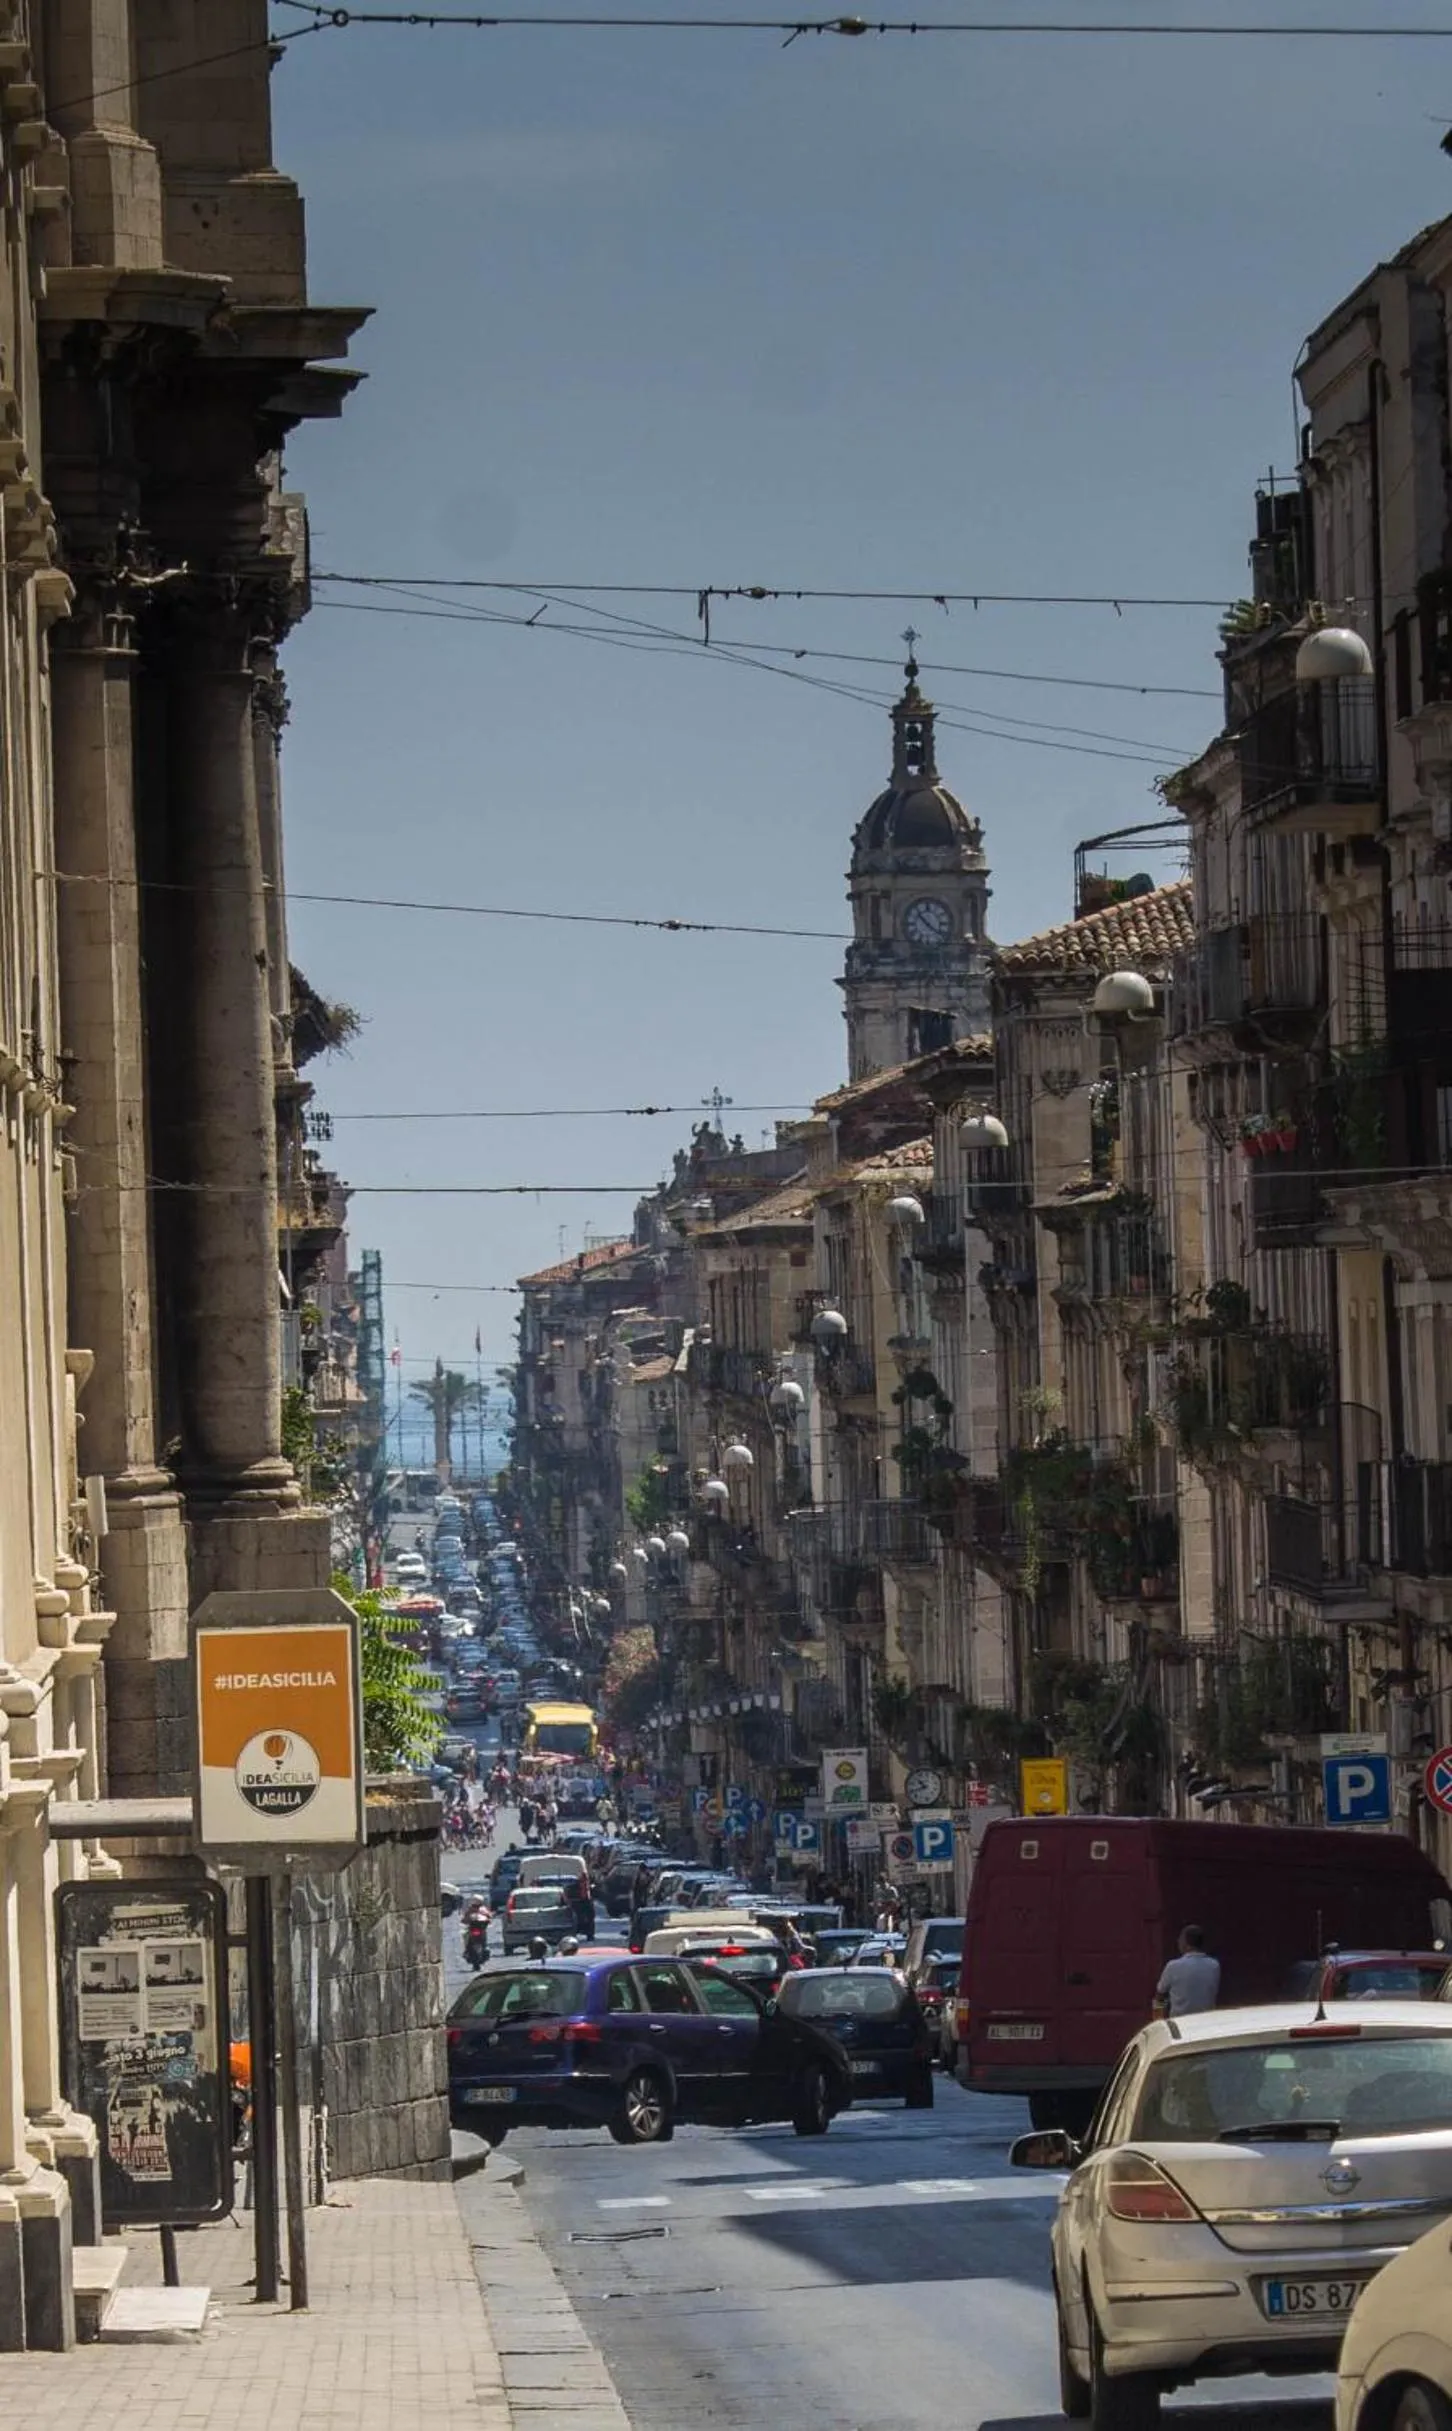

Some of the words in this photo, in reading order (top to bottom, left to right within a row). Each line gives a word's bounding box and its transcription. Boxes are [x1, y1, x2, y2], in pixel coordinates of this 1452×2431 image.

[214, 1671, 337, 1690] #IDEASICILIA
[256, 1790, 302, 1806] LAGALLA
[727, 1787, 741, 1807] P
[1338, 1764, 1375, 1814] P
[779, 1812, 797, 1836] P
[796, 1824, 815, 1848] P
[923, 1826, 945, 1857] P
[135, 2048, 143, 2059] 3
[146, 2046, 186, 2060] giugno
[1286, 2284, 1317, 2310] DS
[1327, 2282, 1369, 2309] 87
